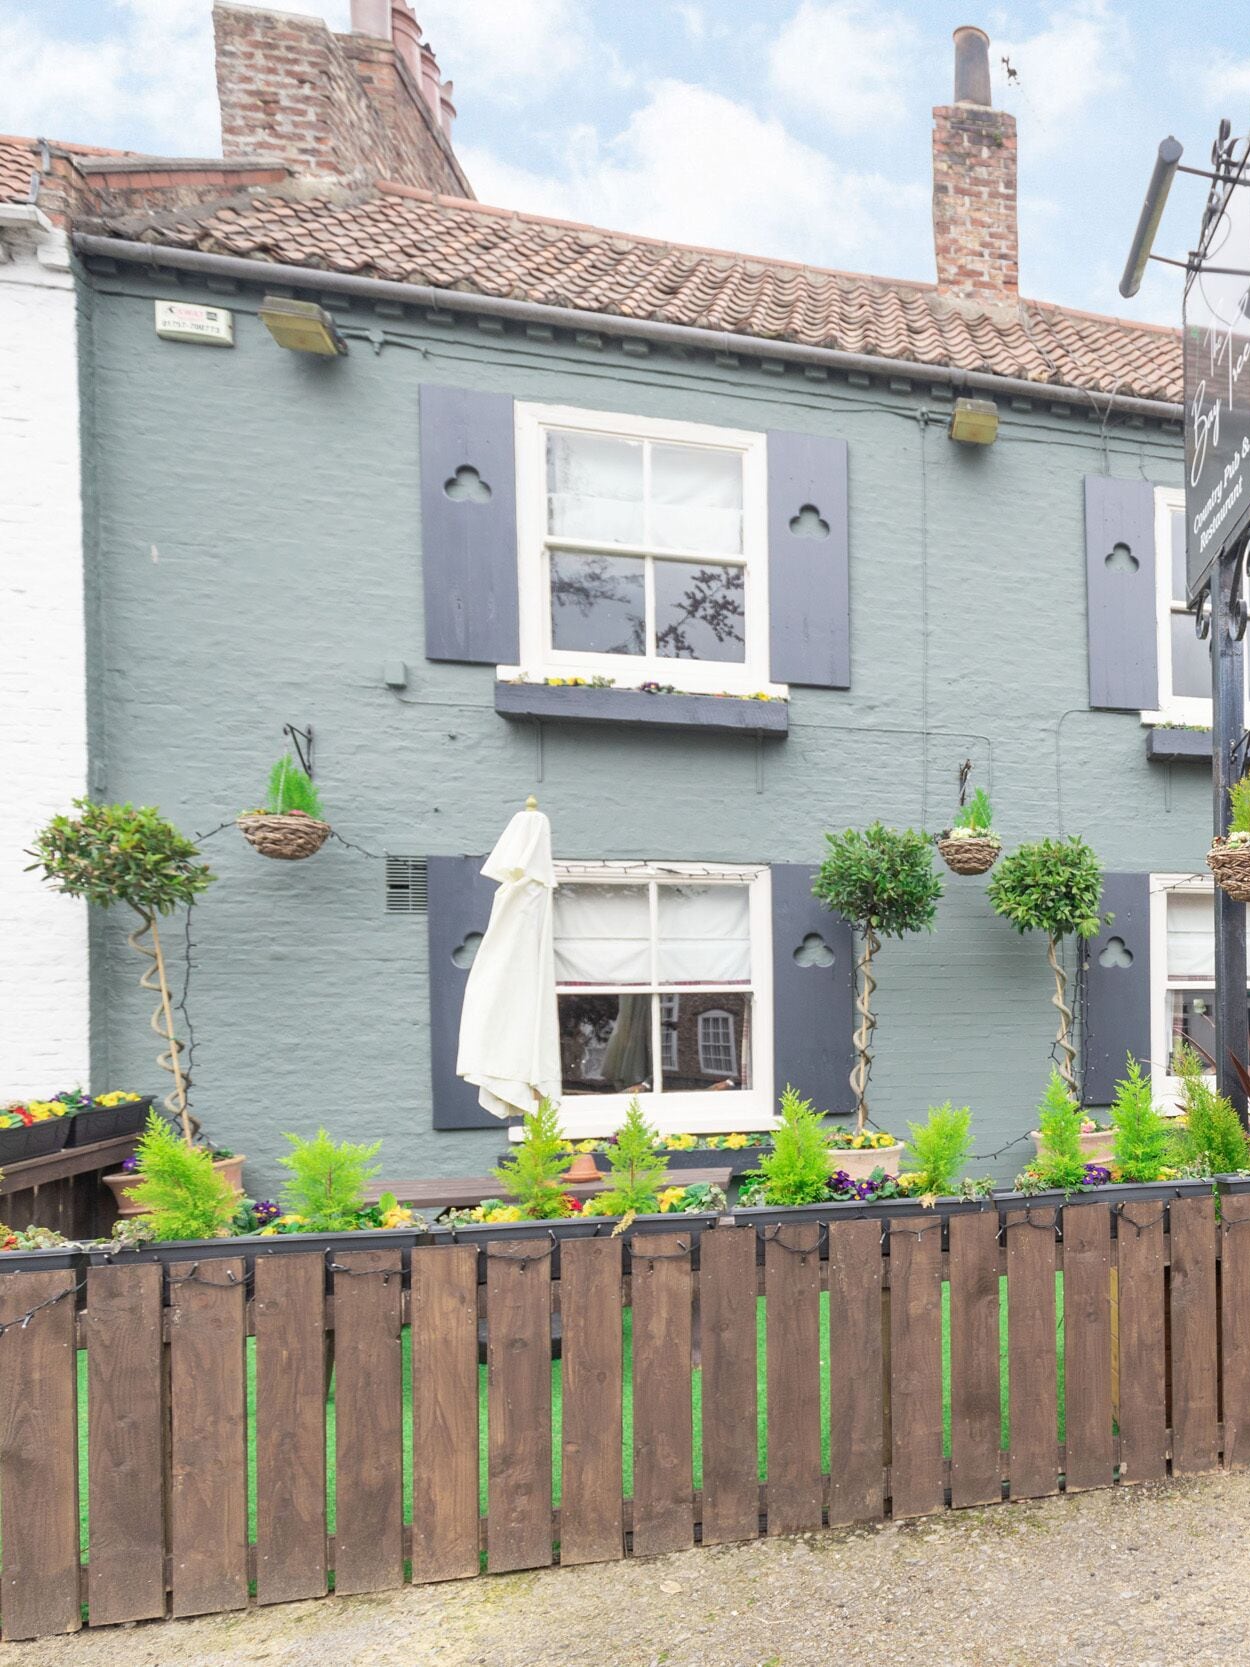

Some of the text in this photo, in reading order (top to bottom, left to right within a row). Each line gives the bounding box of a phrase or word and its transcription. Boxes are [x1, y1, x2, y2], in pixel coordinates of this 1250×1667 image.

[1190, 379, 1222, 487] Bay
[1193, 436, 1250, 534] Country Pub &
[1200, 475, 1243, 553] Restaurant
